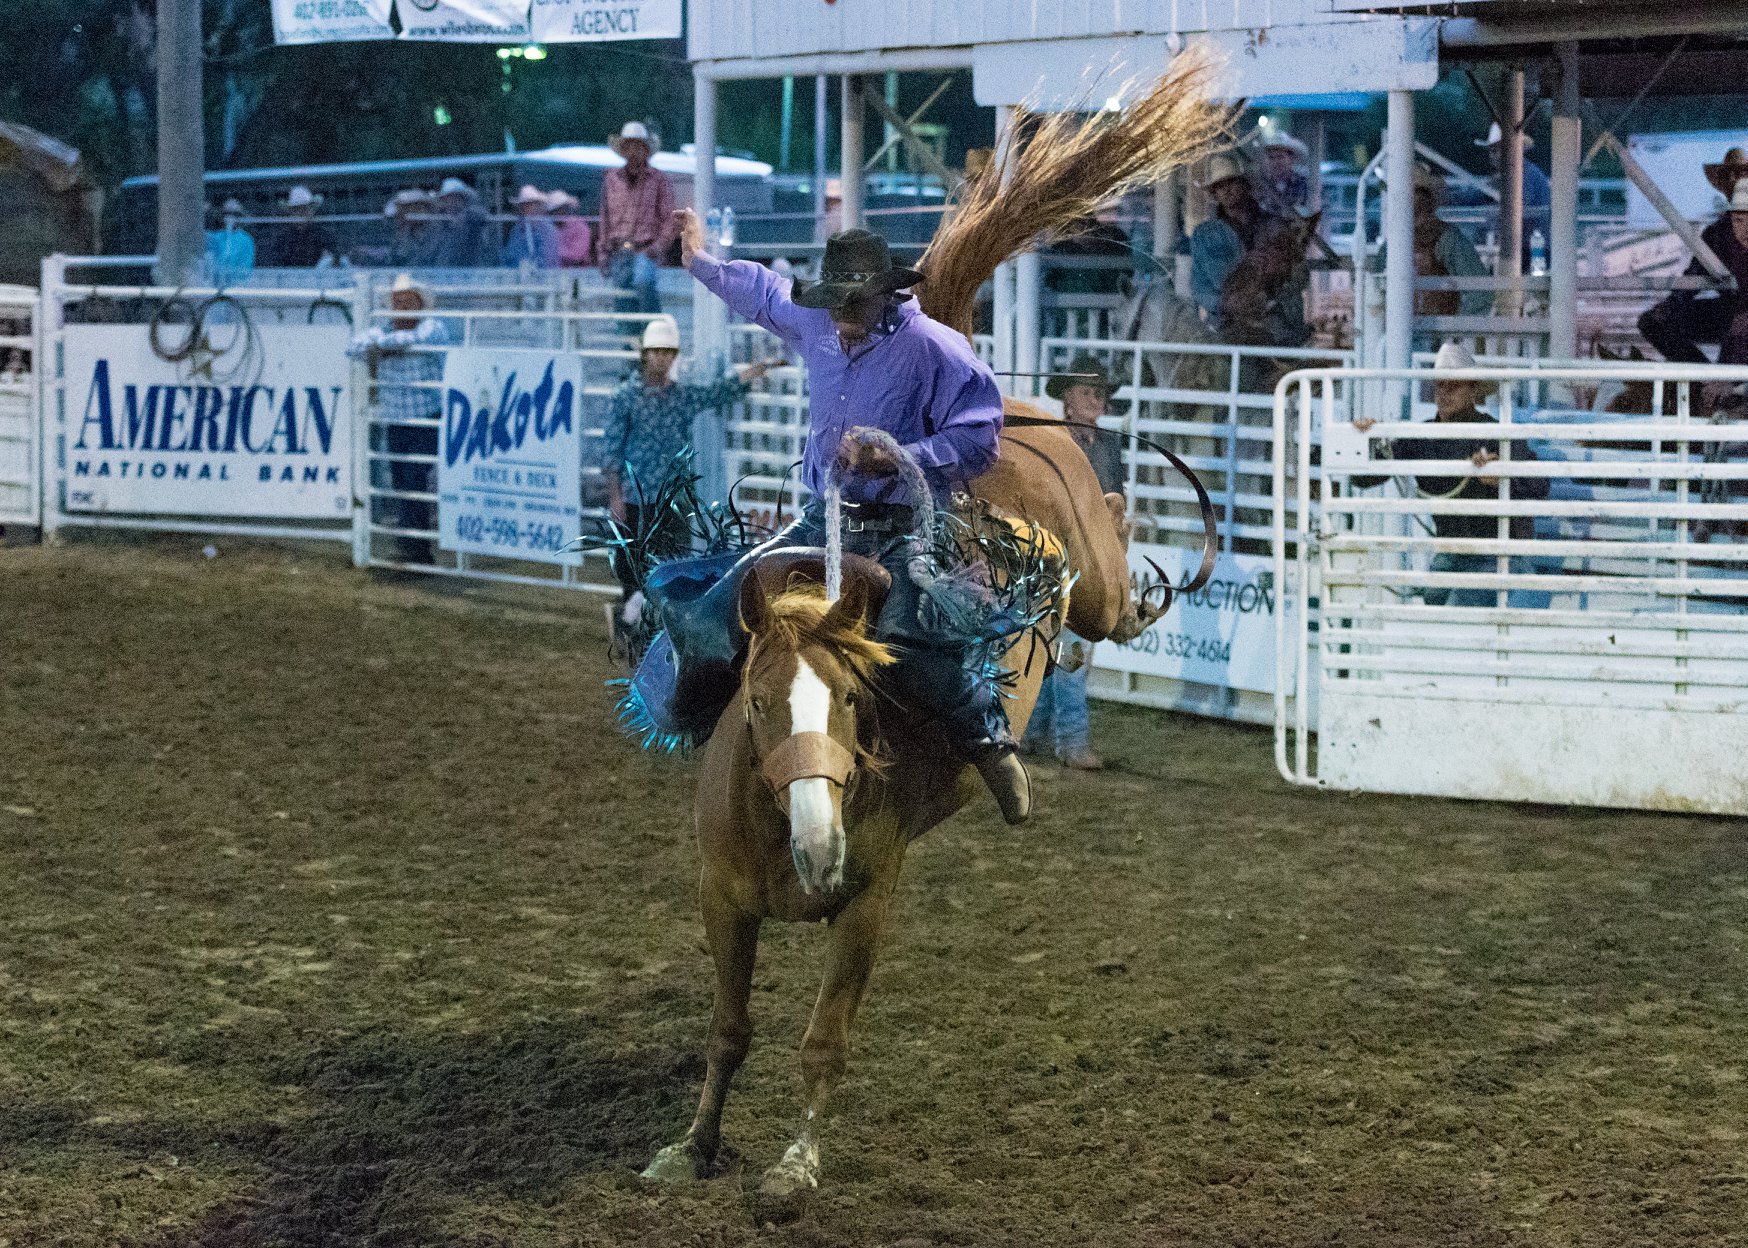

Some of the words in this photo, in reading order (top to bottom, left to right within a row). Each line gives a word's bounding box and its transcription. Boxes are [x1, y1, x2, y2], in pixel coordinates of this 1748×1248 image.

[571, 8, 640, 35] AGENCY
[74, 358, 343, 455] AMERICAN
[75, 461, 230, 483] NATIONAL
[258, 463, 342, 484] BANK
